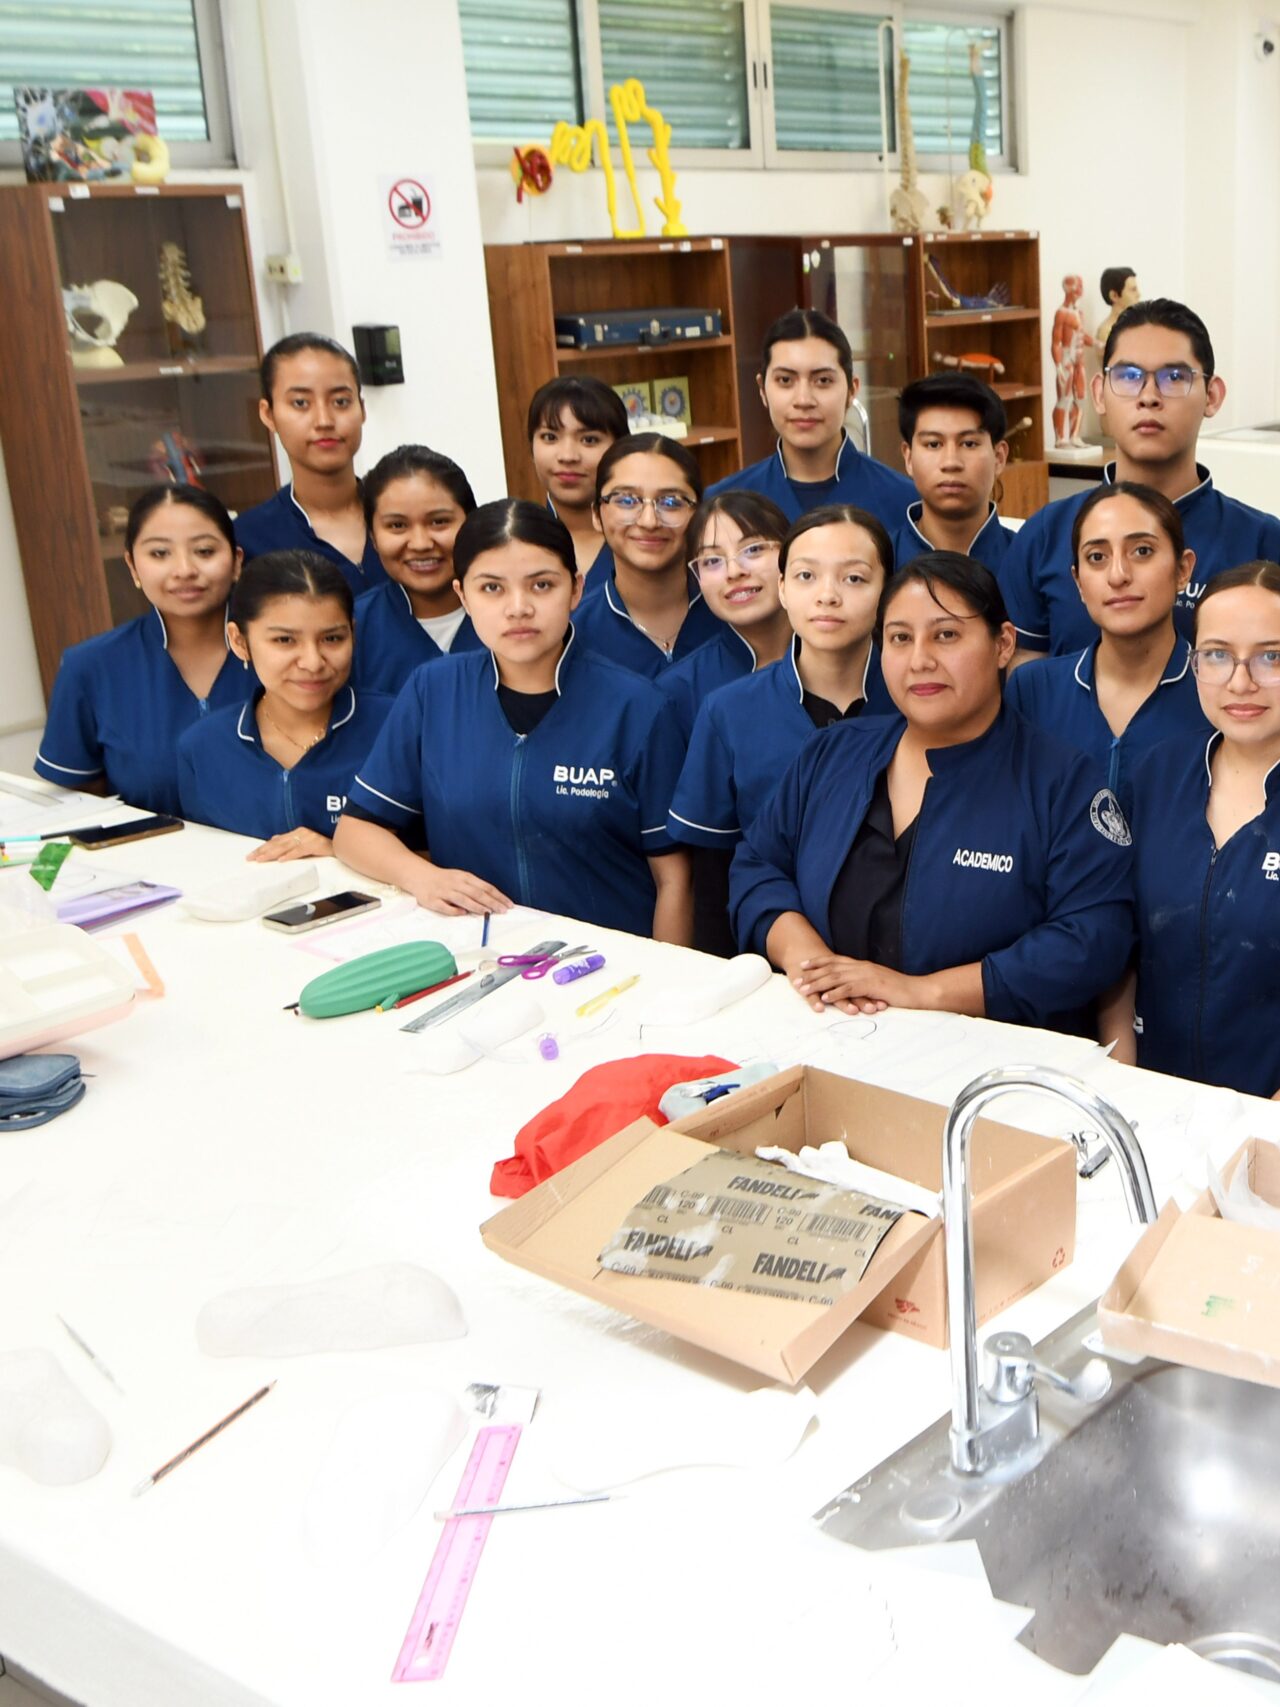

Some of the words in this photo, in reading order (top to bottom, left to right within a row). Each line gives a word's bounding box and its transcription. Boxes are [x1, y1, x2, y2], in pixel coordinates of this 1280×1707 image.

[553, 765, 615, 786] BUAP
[952, 848, 1013, 873] ACADEMICO
[1265, 870, 1279, 881] Lic.
[727, 1176, 803, 1201] FANDELI
[774, 1216, 794, 1226] 120
[623, 1229, 697, 1262] FANDELI
[752, 1252, 828, 1284] FANDELI
